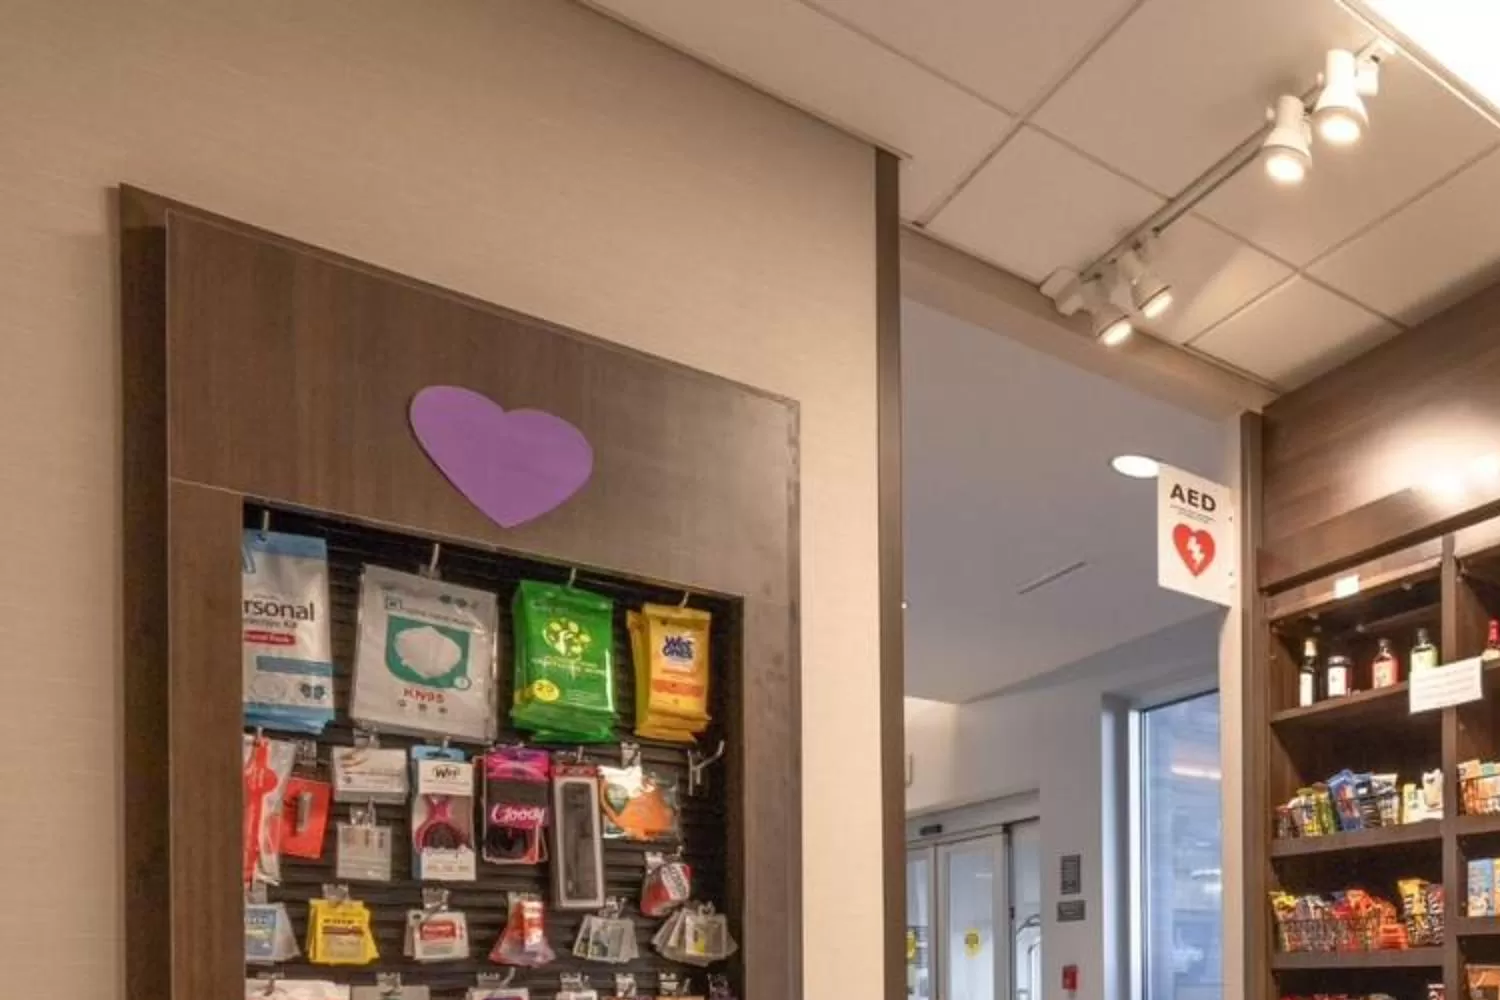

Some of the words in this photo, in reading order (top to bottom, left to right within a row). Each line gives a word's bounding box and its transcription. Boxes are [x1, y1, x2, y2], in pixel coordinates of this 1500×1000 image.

[1169, 483, 1217, 512] AED
[244, 600, 315, 622] rsonal
[490, 804, 545, 825] Goody
